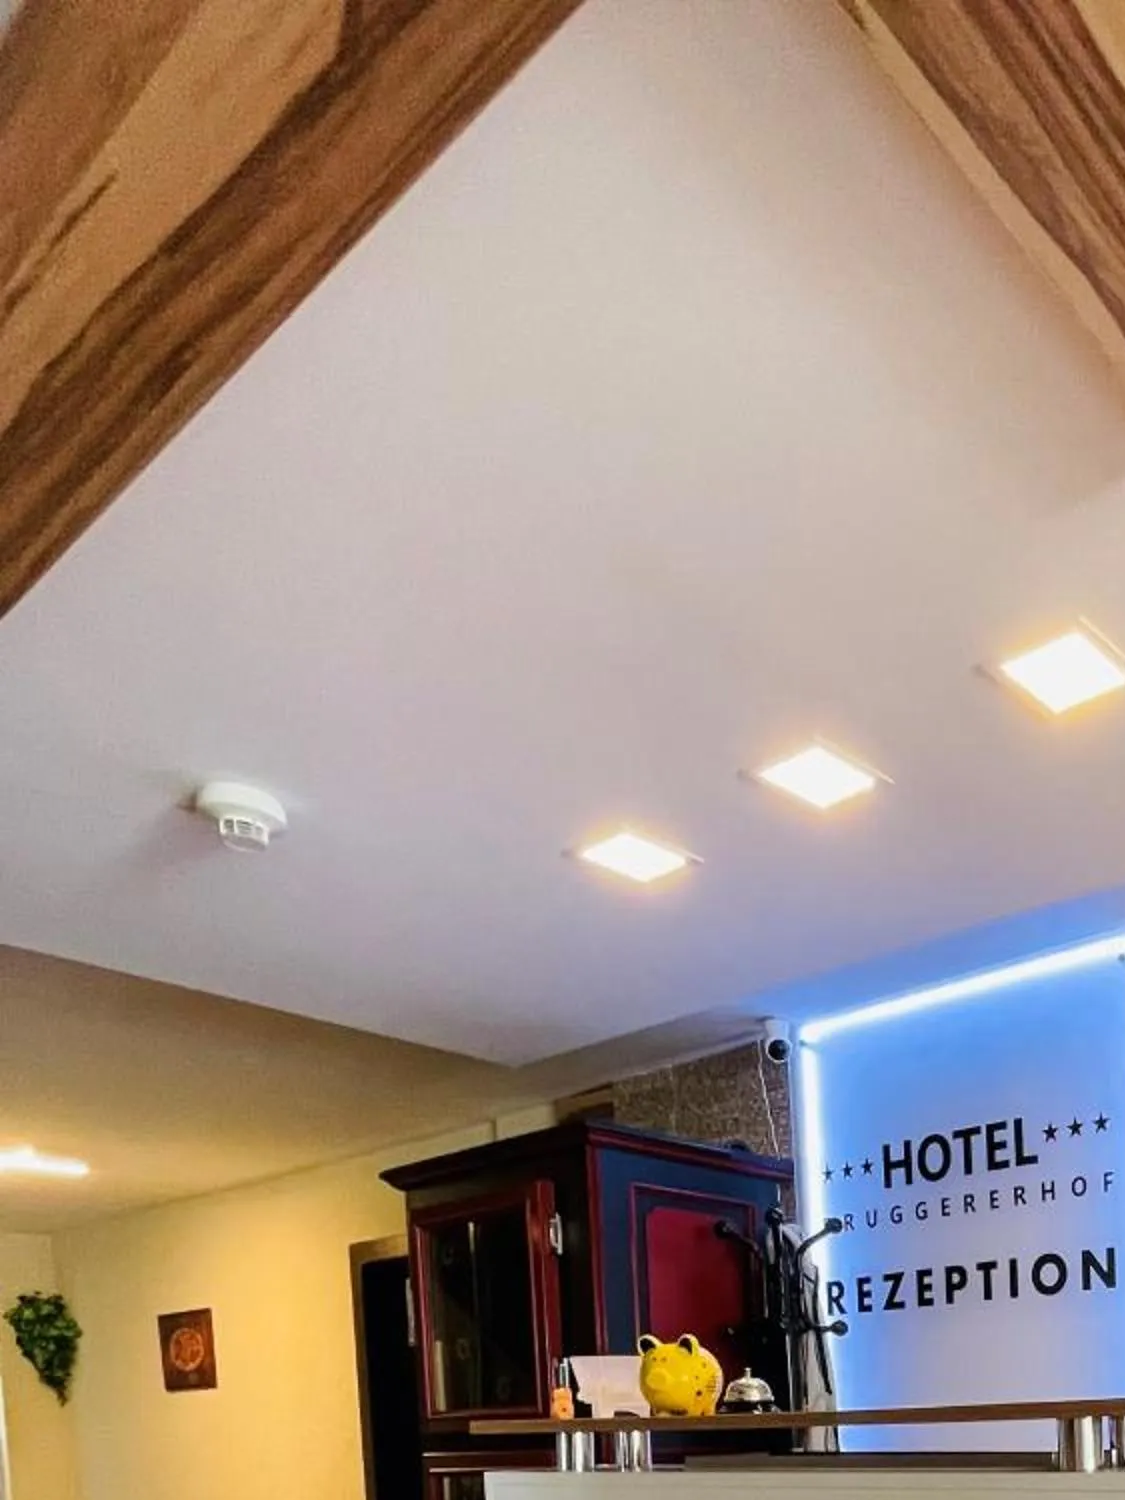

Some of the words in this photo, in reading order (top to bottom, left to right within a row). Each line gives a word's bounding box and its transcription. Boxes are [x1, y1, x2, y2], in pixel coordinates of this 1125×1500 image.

[882, 1117, 1039, 1189] HOTEL
[840, 1171, 1116, 1231] RUGGERERHOF
[826, 1247, 1117, 1316] REZEPTION
